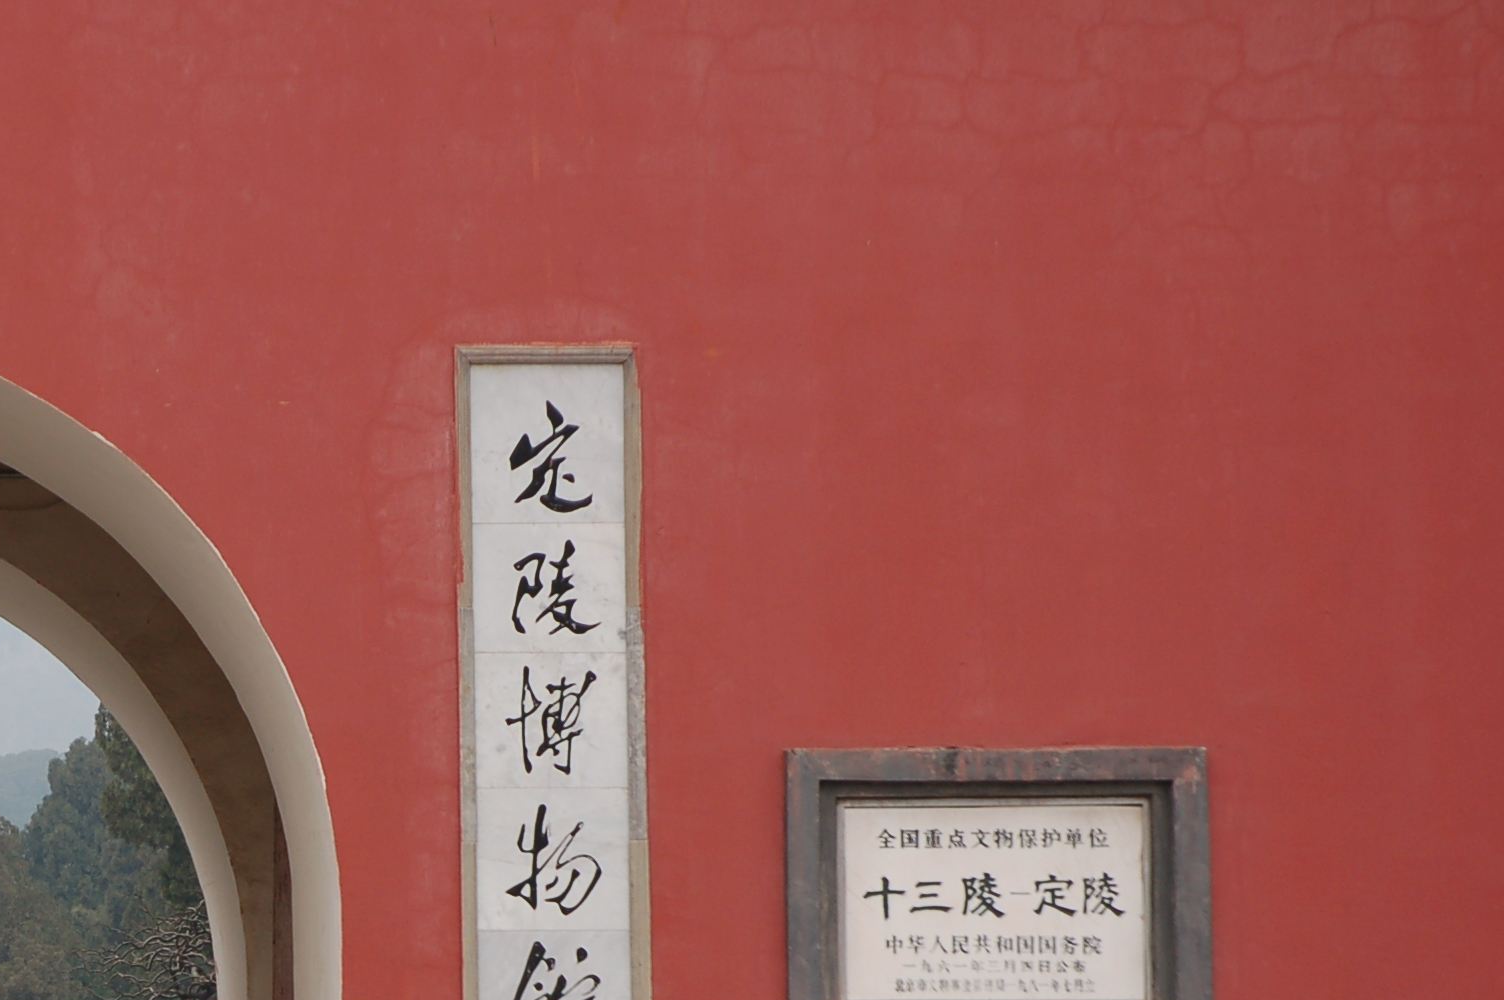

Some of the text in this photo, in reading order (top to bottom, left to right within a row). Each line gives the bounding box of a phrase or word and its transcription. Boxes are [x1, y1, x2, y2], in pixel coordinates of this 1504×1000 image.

[876, 827, 1111, 850] 全国重点文物保护单位
[885, 934, 1104, 956] 中华人民共和国国务院
